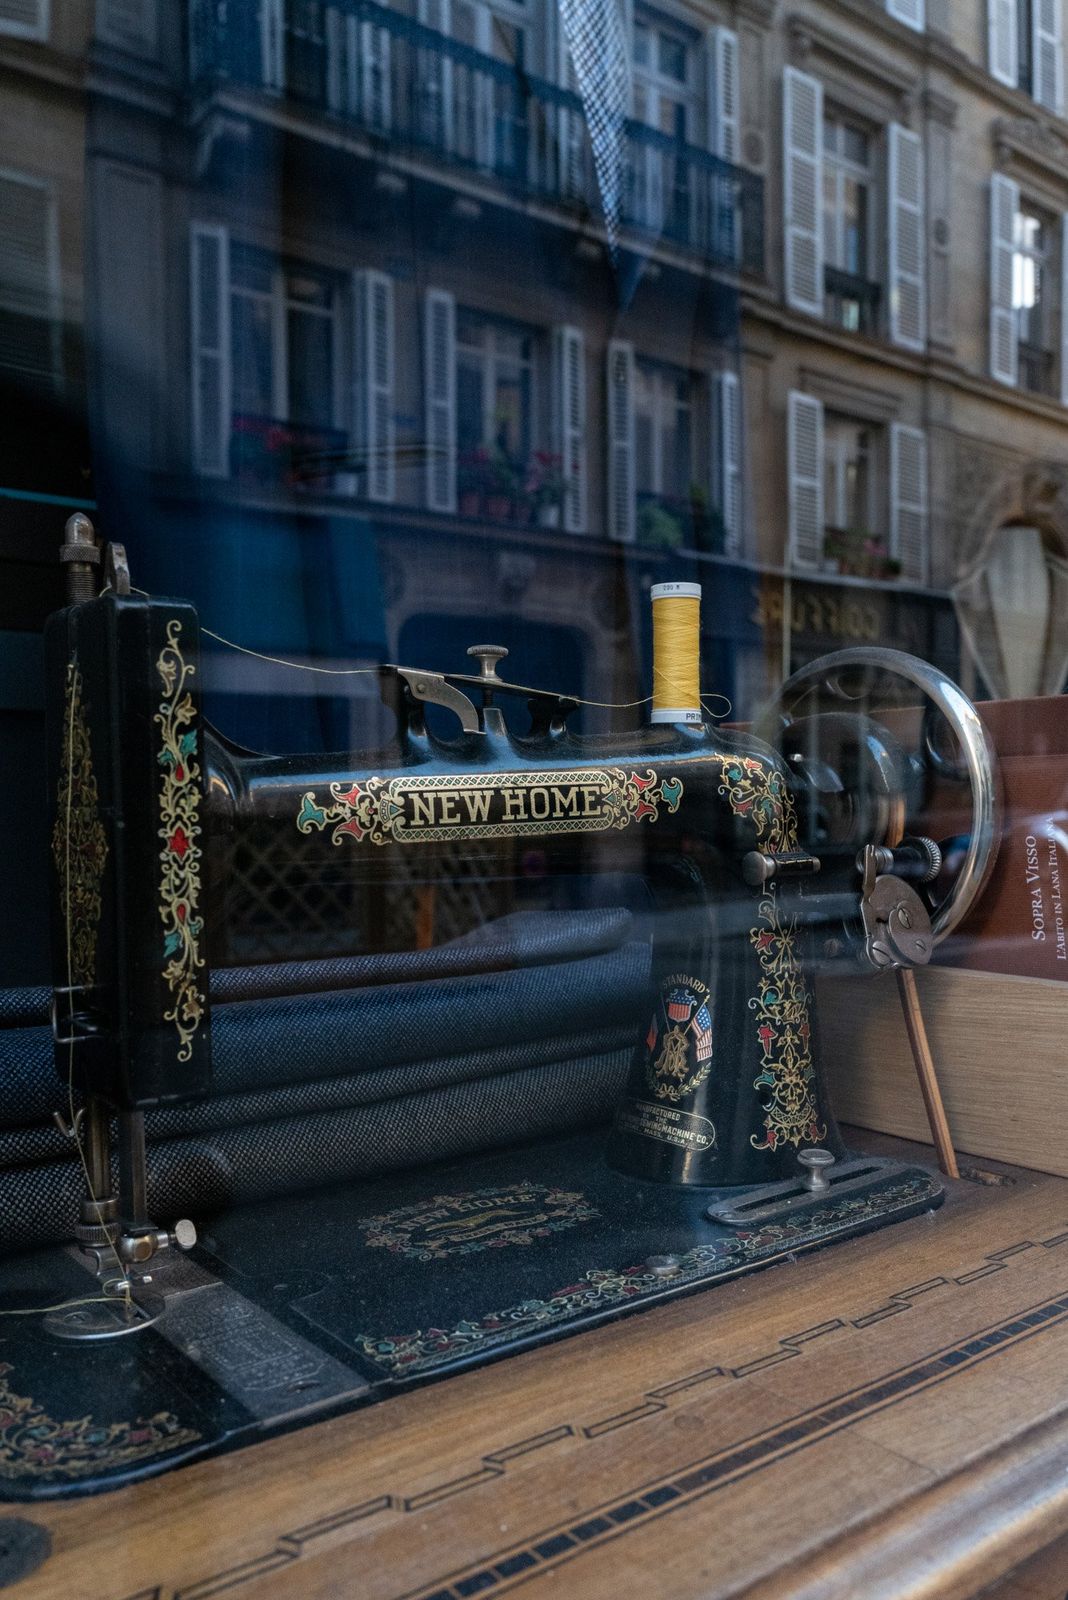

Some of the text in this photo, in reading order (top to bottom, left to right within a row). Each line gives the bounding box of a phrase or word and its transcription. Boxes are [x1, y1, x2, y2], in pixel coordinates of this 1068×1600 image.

[408, 785, 602, 826] NEW HOME
[1025, 835, 1046, 941] SOPRA VISSO
[1051, 870, 1061, 899] LANA
[1054, 902, 1063, 914] IN
[696, 1134, 709, 1145] CO.
[395, 1193, 536, 1231] NEW HOME
